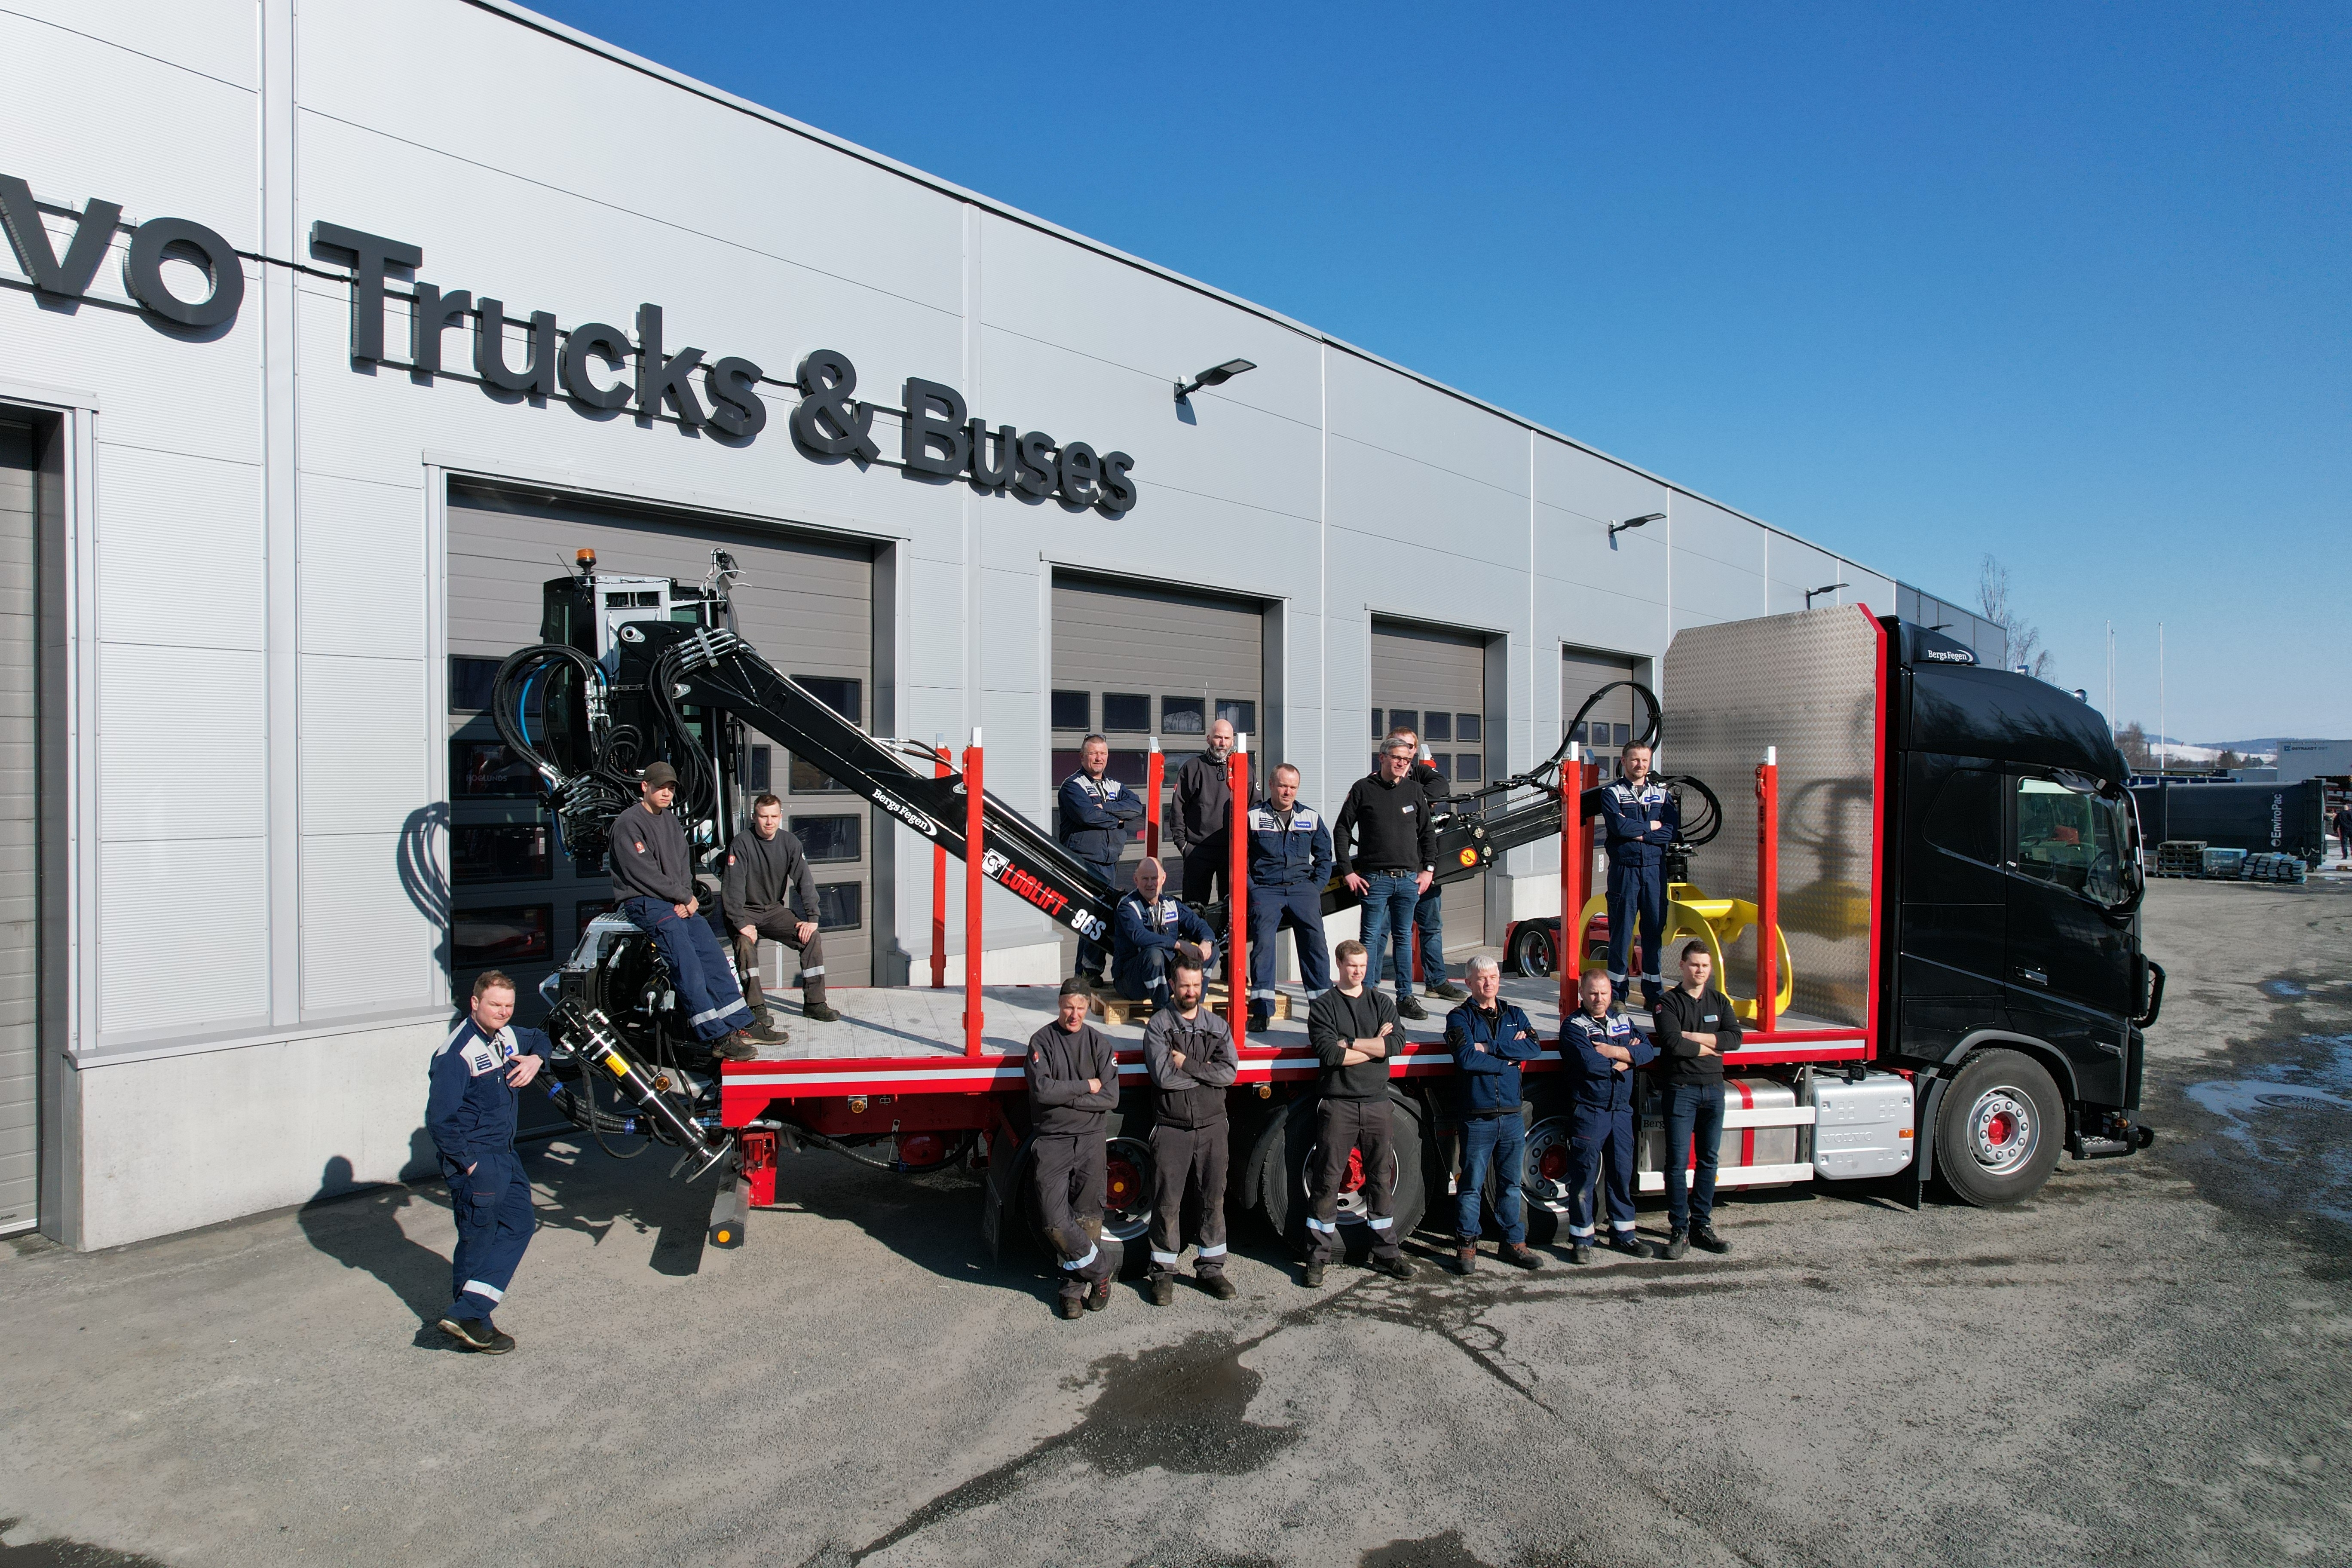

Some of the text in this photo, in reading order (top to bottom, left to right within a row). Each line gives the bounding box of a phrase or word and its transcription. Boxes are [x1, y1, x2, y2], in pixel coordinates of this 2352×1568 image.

[312, 220, 766, 436] Trucks
[796, 349, 880, 462] &
[906, 377, 1137, 512] Buses
[2271, 794, 2282, 838] EnviroPac
[1000, 863, 1106, 940] LOGLIFT 96S
[1821, 1132, 1874, 1143] VOLVO
